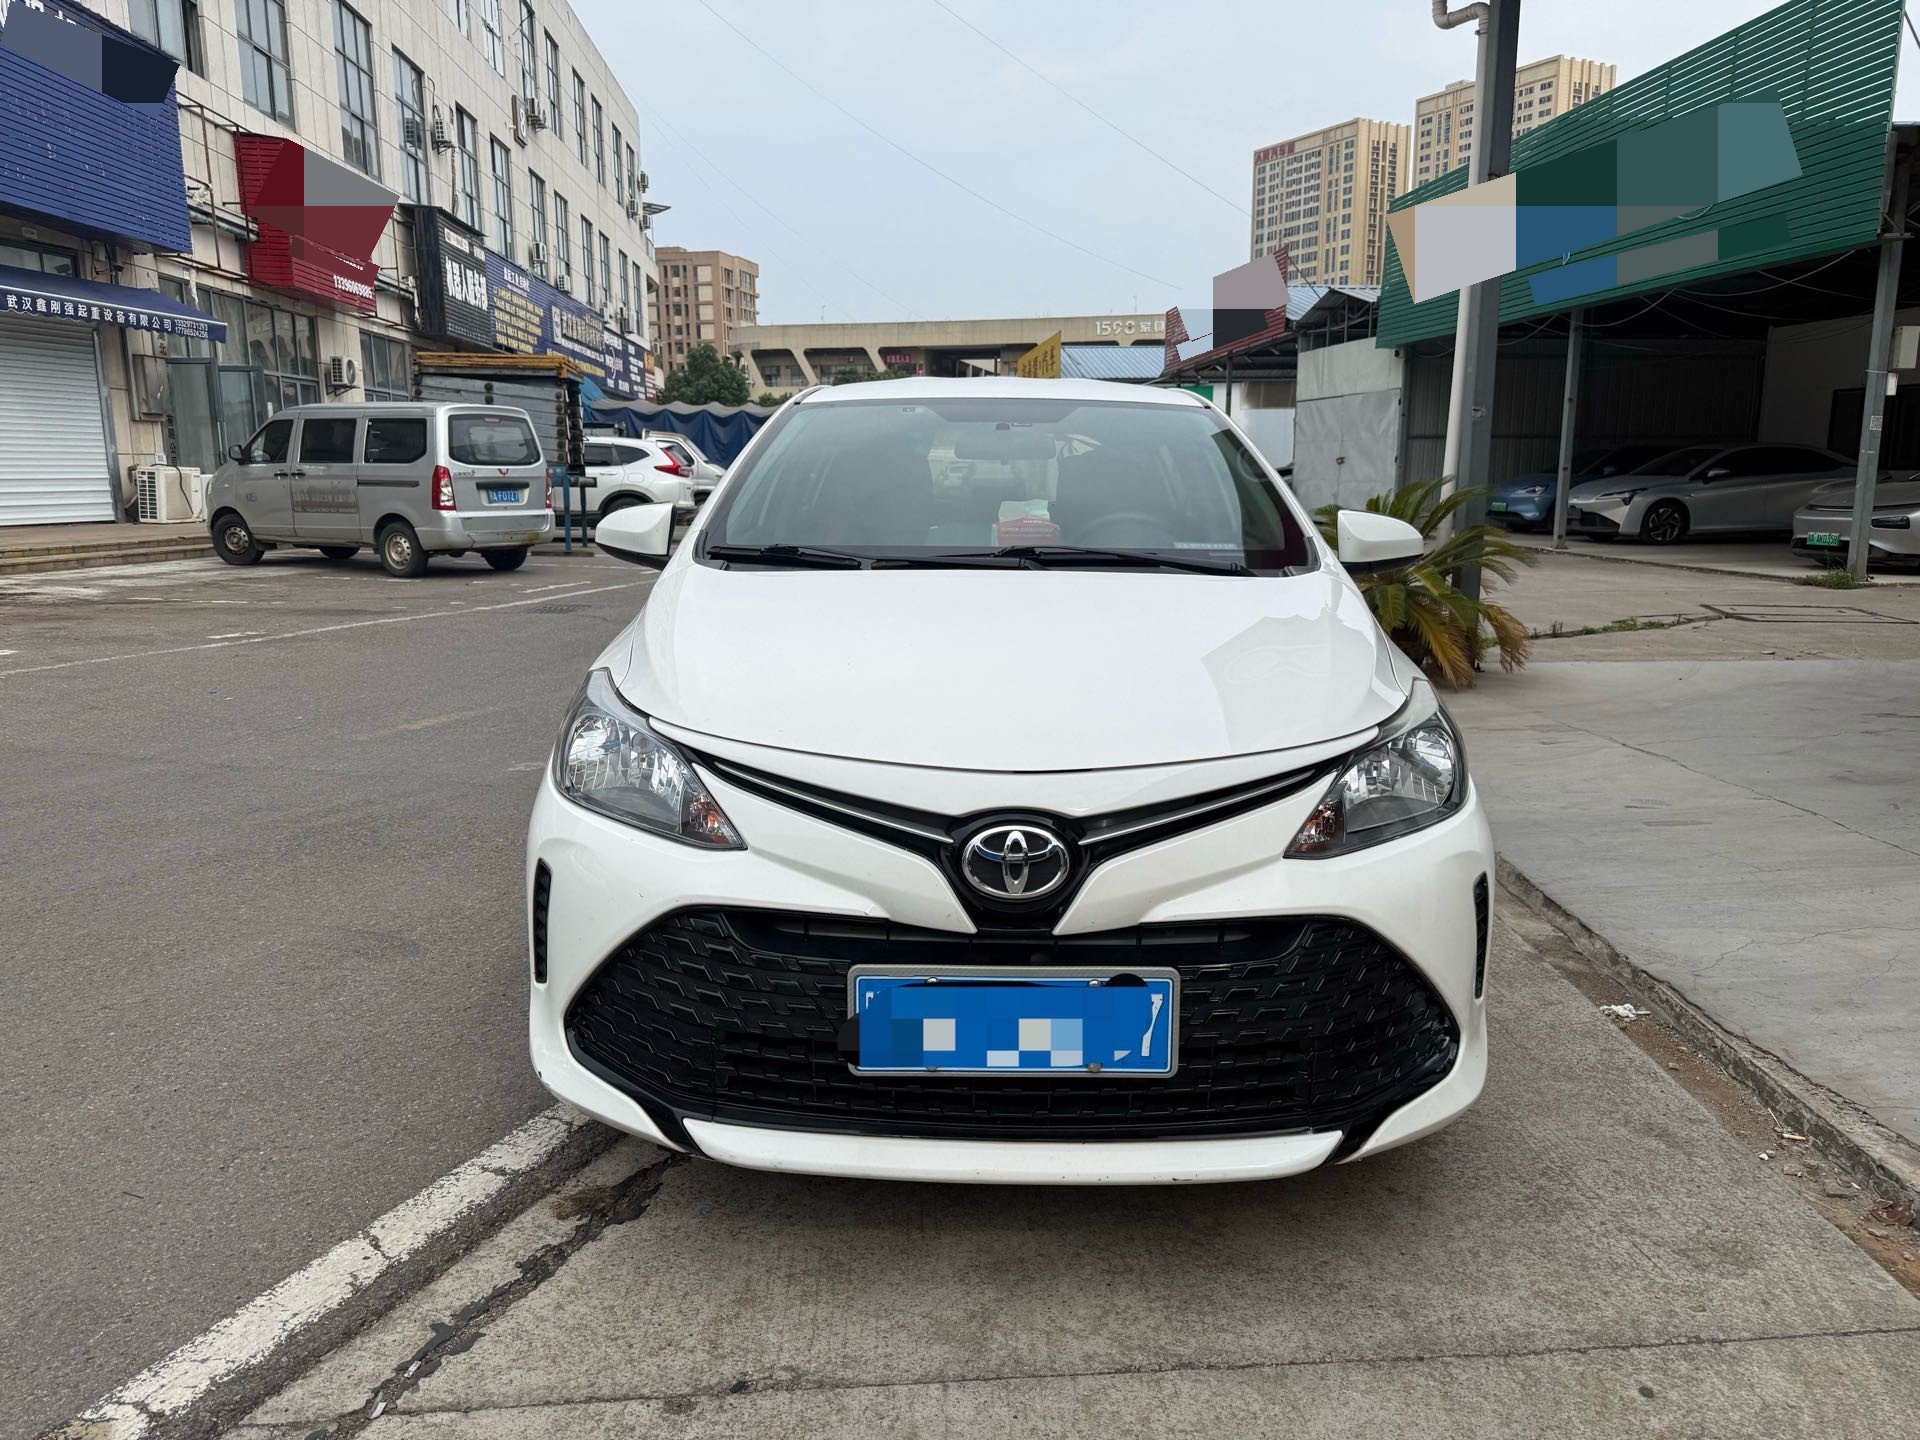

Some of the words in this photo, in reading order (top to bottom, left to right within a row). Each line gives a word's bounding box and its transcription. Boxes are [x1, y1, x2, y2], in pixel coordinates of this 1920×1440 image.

[6, 294, 172, 331] 武汉鑫刚强起重设备有限公司
